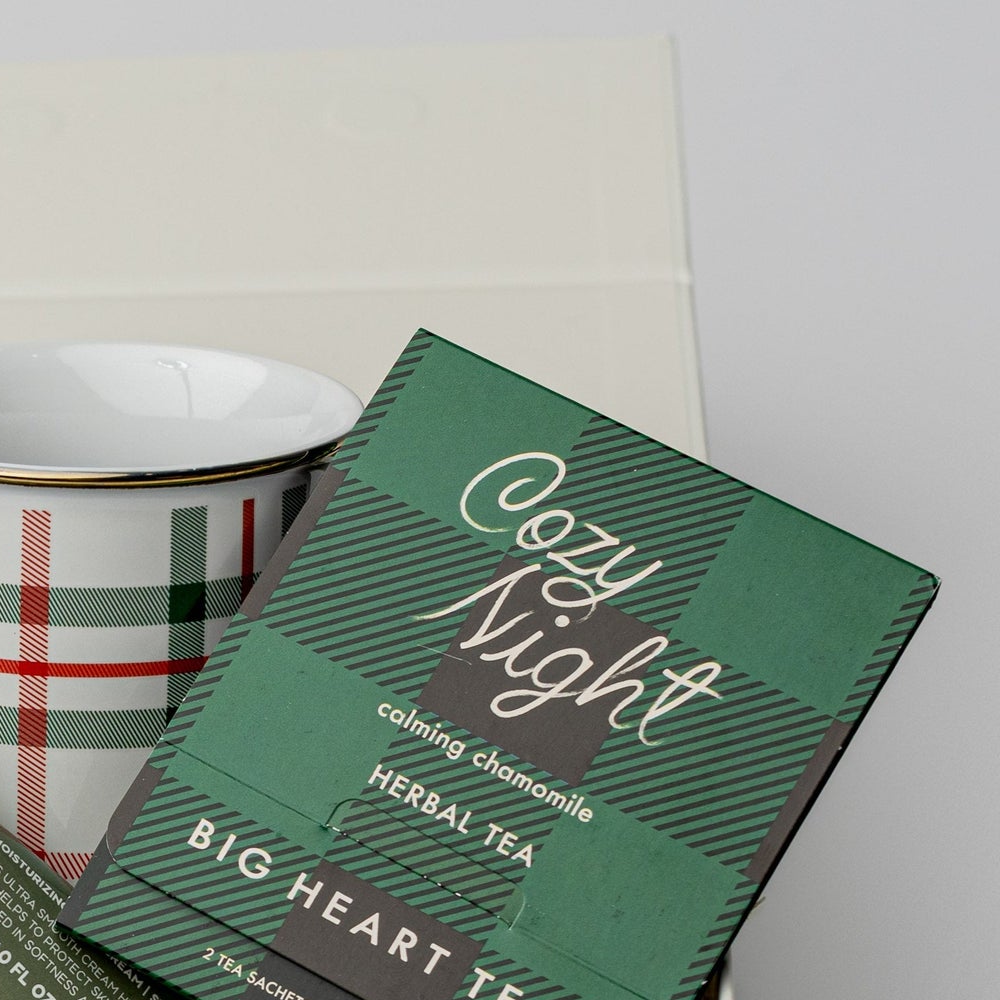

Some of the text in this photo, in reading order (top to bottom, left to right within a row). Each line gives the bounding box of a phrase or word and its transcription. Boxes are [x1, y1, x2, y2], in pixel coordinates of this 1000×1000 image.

[460, 452, 663, 623] Cozy
[410, 563, 723, 746] Night
[376, 700, 595, 823] calming chamomile
[367, 764, 535, 869] HERBAL TEA
[3, 872, 36, 911] ULTRA
[81, 954, 119, 995] CREAM
[186, 817, 274, 880] BIG
[286, 872, 452, 976] HEART
[9, 961, 30, 986] FL
[11, 926, 27, 942] IN
[24, 939, 79, 996] SOFTNESS
[28, 919, 44, 938] TO
[43, 935, 93, 986] PROTECT
[105, 953, 145, 989] REAM
[202, 947, 215, 962] 2
[216, 953, 244, 978] TEA
